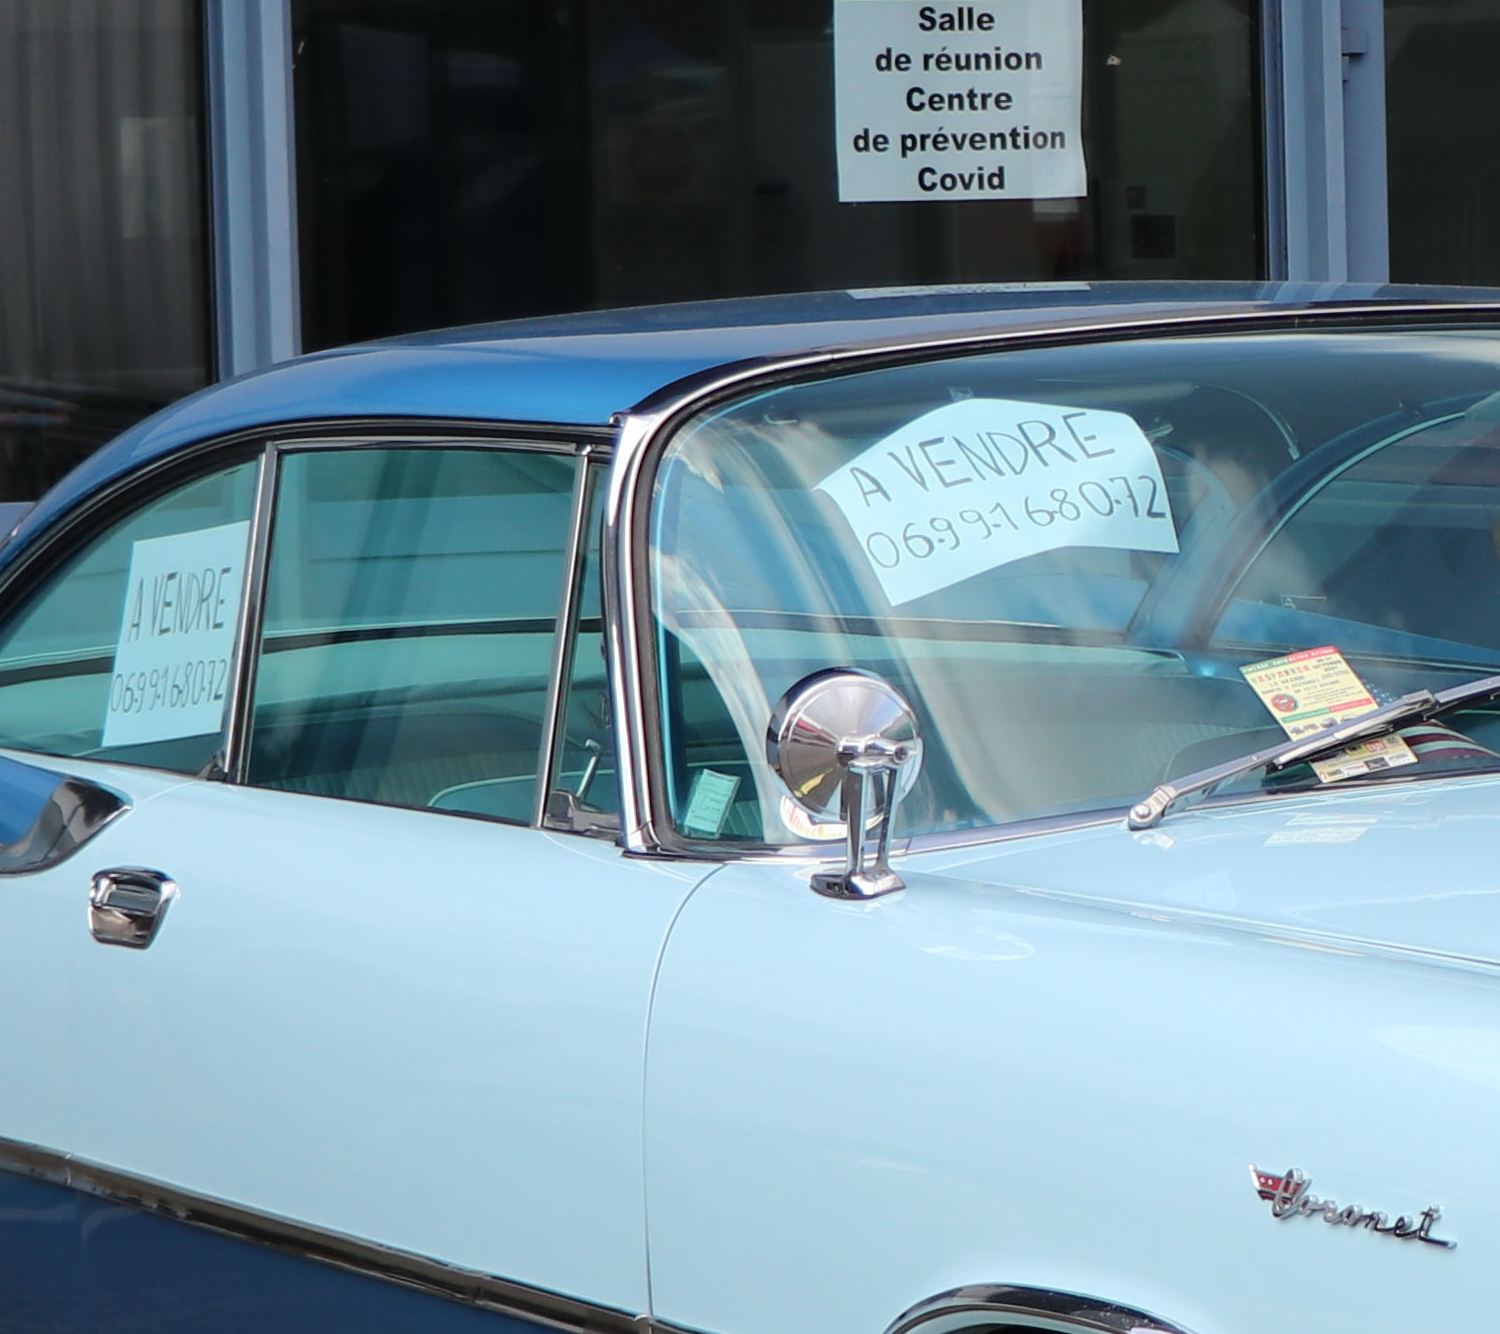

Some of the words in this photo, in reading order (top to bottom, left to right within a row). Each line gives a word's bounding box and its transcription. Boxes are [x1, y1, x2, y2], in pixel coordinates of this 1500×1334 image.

[917, 6, 996, 32] Salle
[875, 47, 912, 72] de
[922, 46, 1043, 72] réunion
[905, 87, 1013, 112] Centre
[853, 128, 890, 153] de
[901, 126, 1066, 158] prévention
[917, 165, 1005, 191] Covid
[849, 465, 892, 508] A
[887, 412, 1116, 492] VENDRE
[127, 576, 144, 643] A
[151, 567, 232, 638] VENDRE
